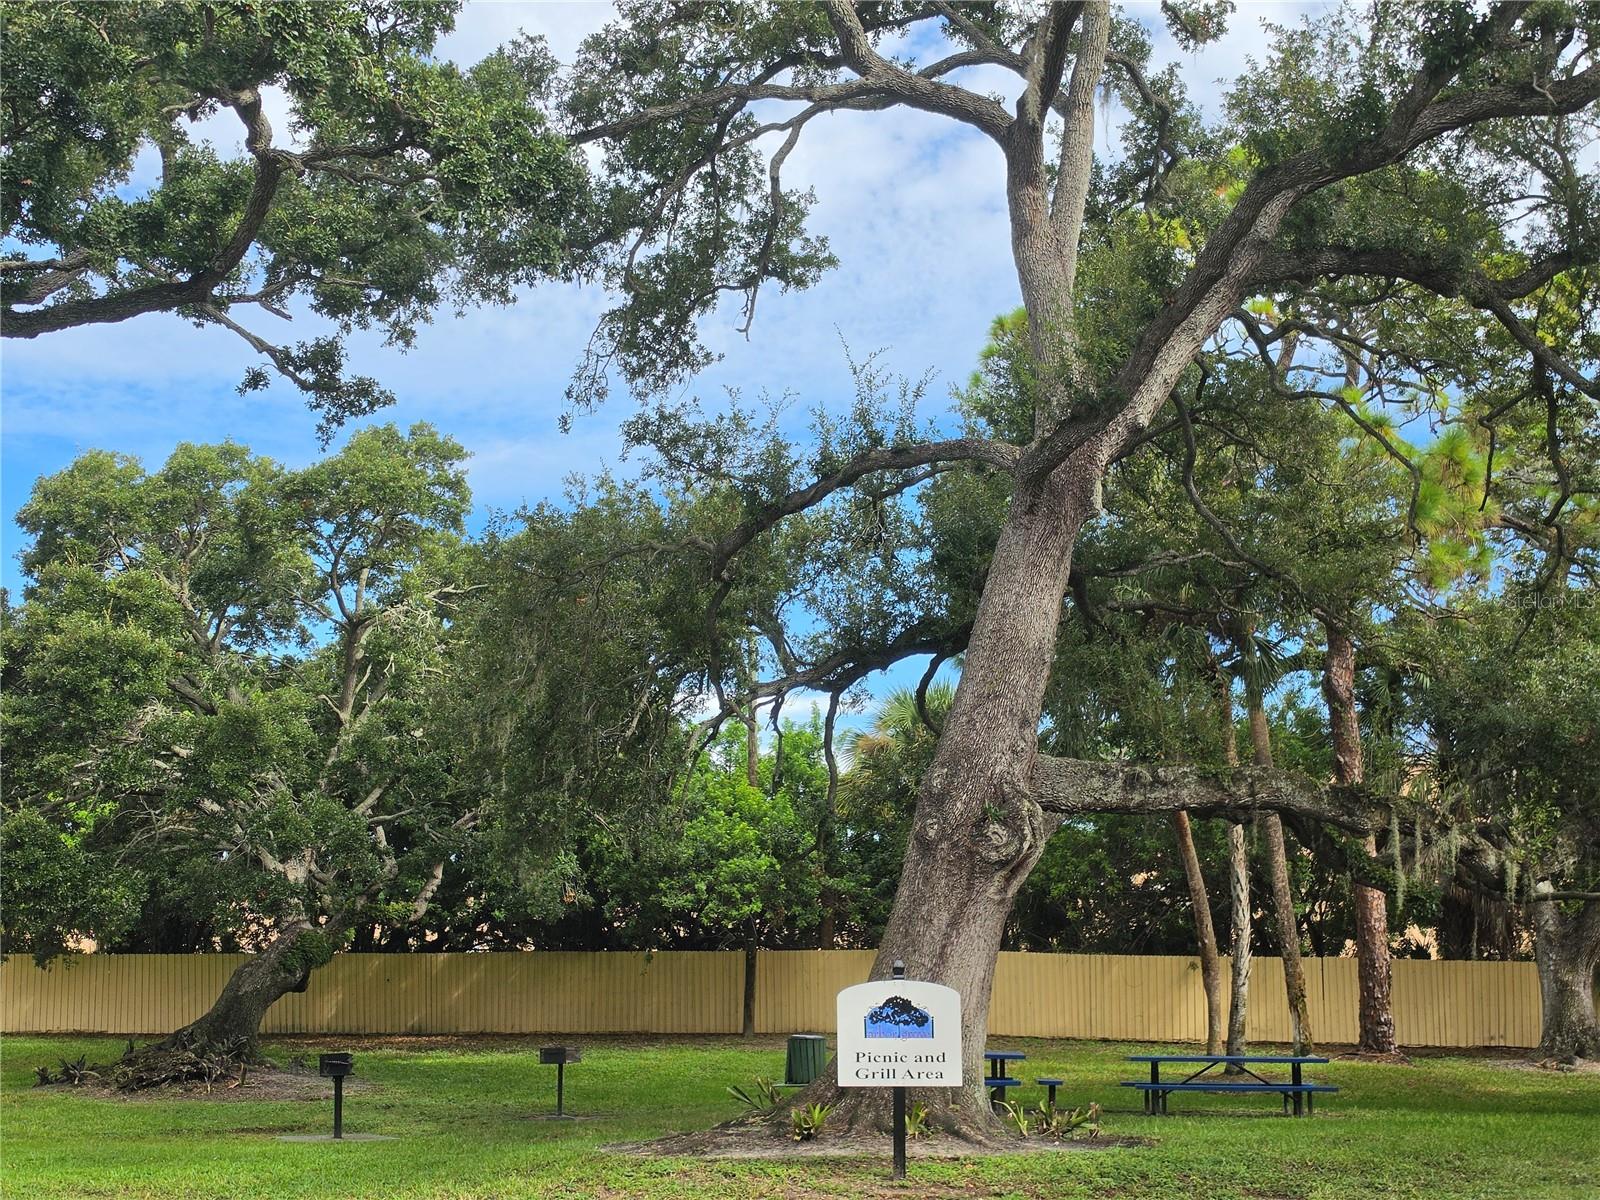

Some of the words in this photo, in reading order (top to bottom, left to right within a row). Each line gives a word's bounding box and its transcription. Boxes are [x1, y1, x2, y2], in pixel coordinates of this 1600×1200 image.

[856, 1052, 908, 1063] Picnic
[914, 1052, 946, 1063] and
[855, 1068, 896, 1080] Grill
[902, 1068, 943, 1080] Area
